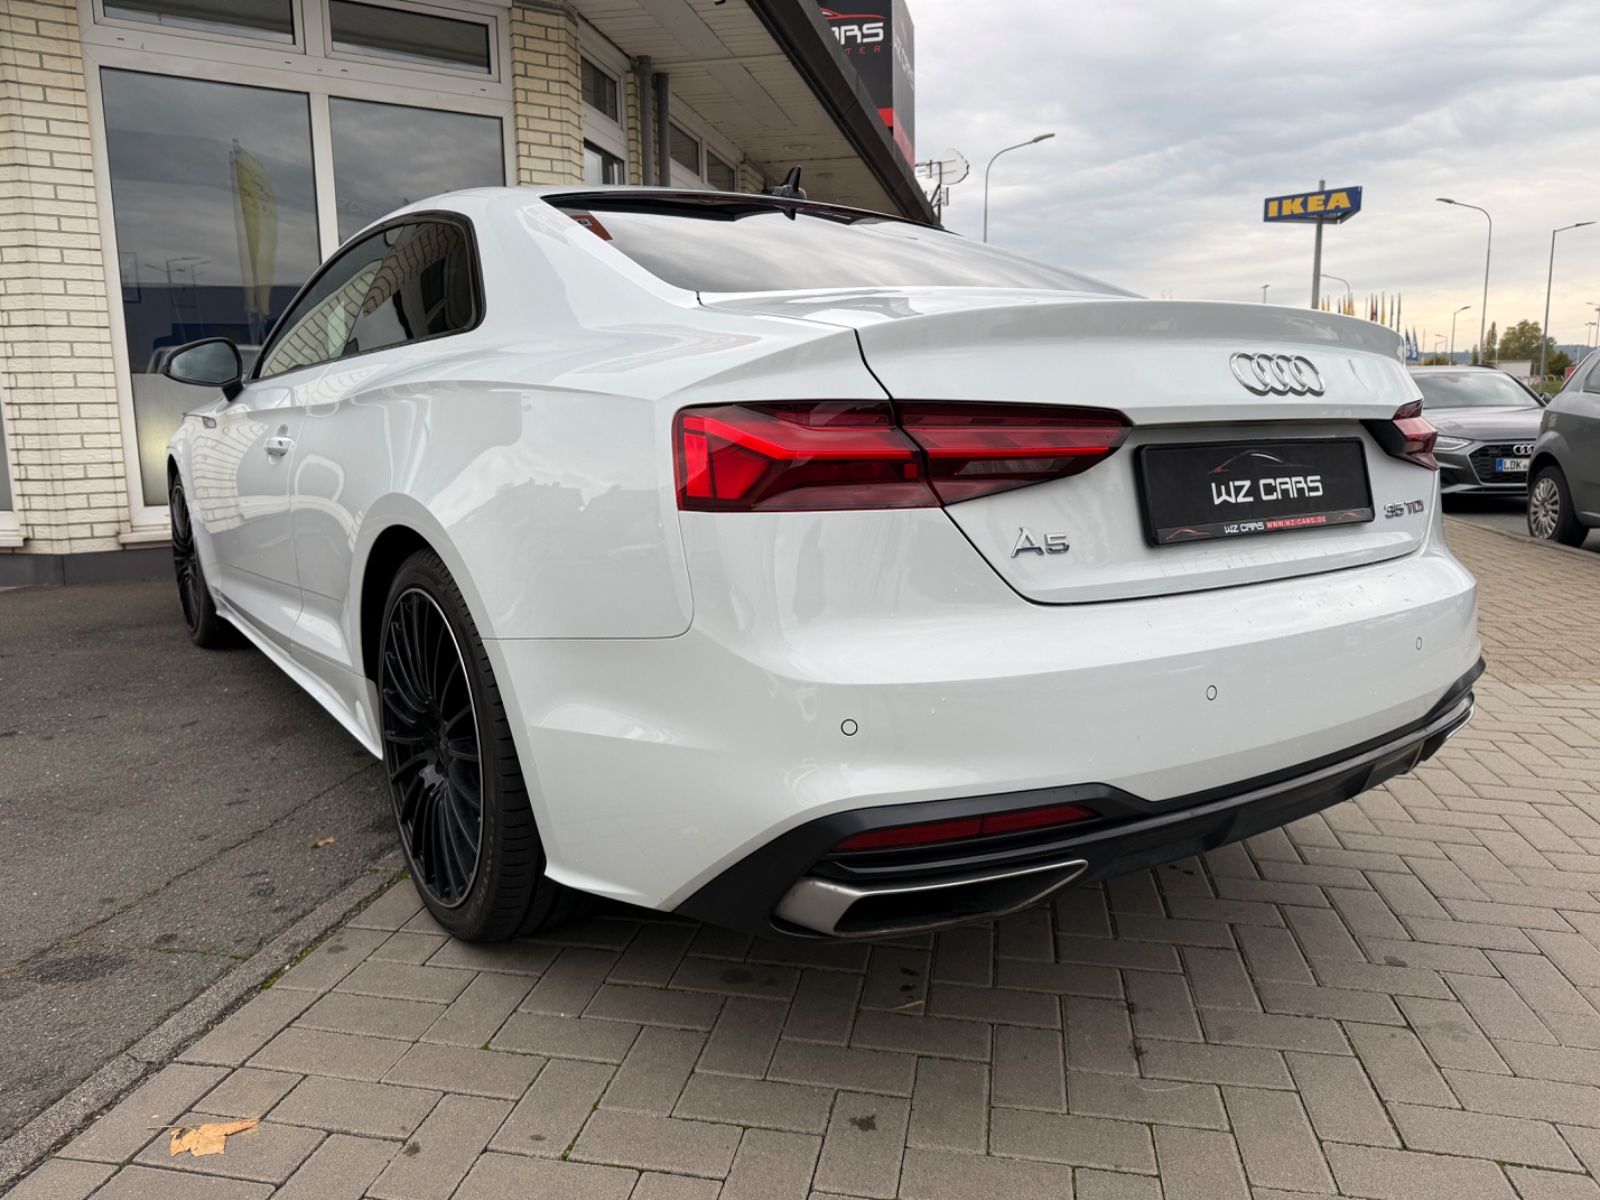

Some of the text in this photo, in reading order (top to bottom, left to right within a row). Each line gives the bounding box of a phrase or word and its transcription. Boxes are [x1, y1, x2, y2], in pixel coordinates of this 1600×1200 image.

[1267, 192, 1351, 217] IKEA
[1503, 460, 1522, 470] LDK
[1211, 475, 1323, 505] WZ CARS
[1383, 499, 1424, 519] 35 TDI
[1224, 524, 1239, 533] WZ
[1240, 521, 1264, 532] CARS
[1010, 527, 1070, 559] A5
